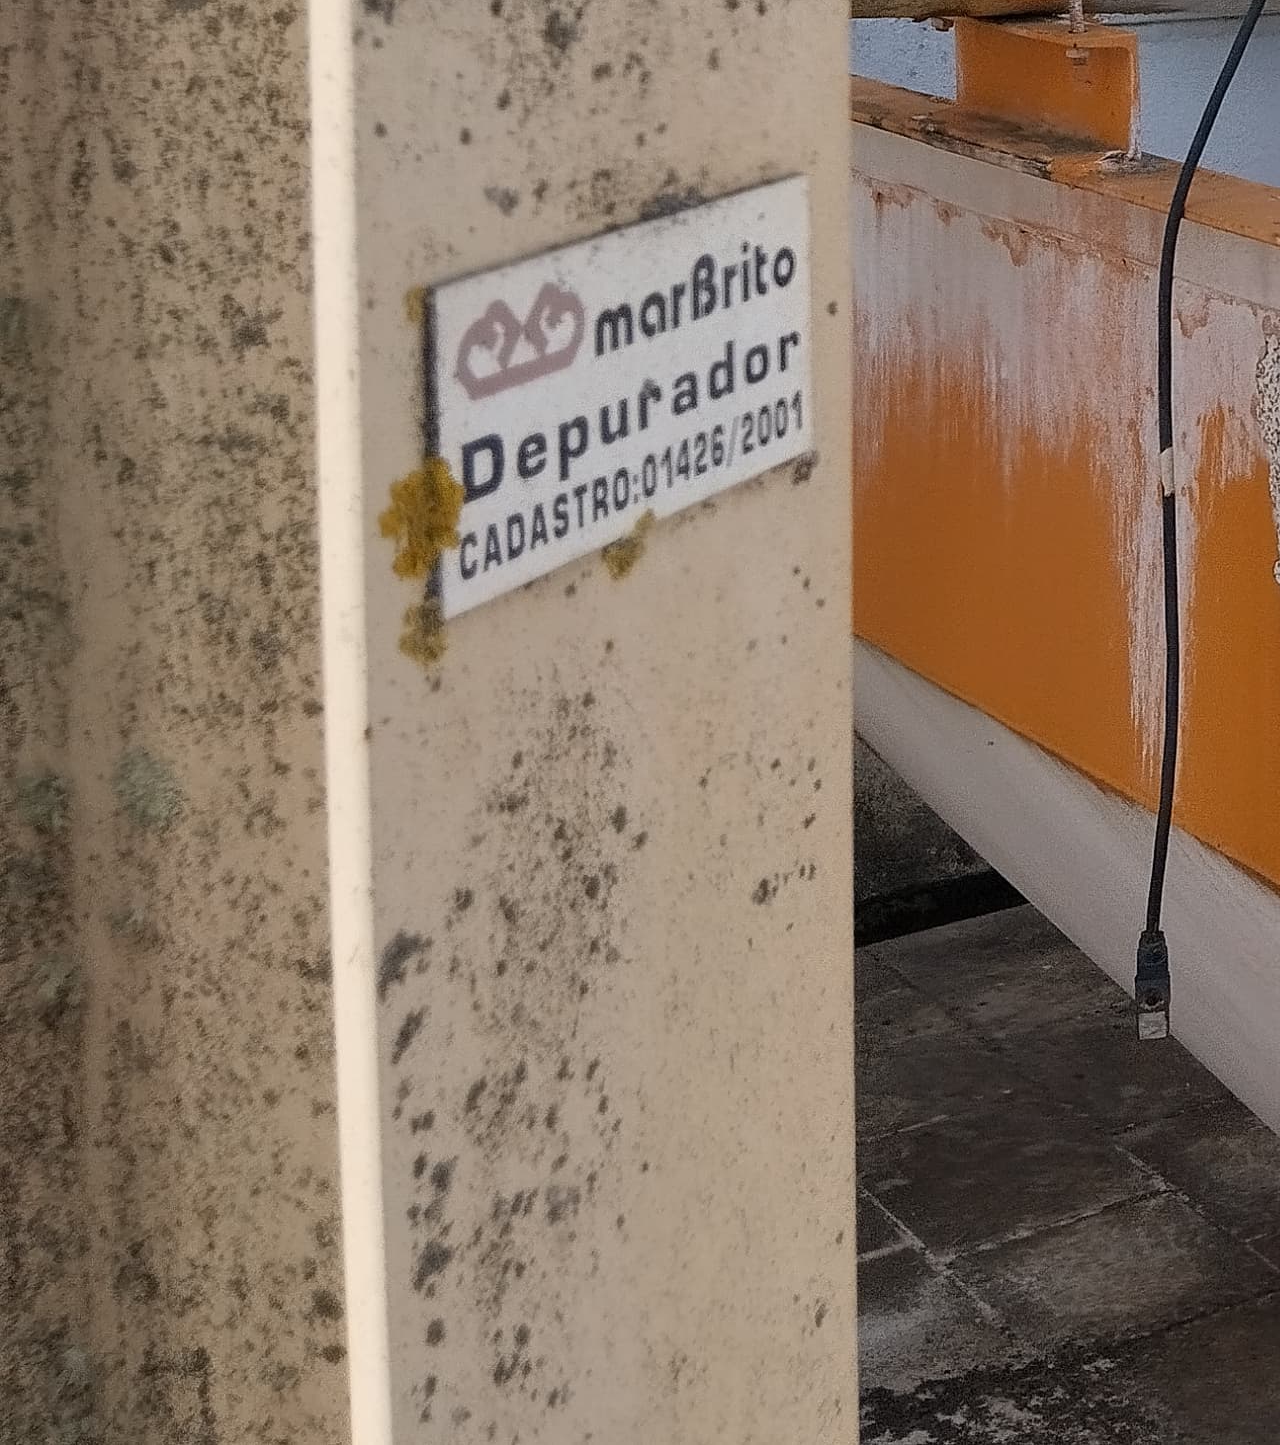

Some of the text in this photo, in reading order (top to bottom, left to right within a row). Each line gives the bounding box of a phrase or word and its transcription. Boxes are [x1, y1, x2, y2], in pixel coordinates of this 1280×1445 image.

[595, 242, 796, 355] marBrito
[459, 390, 803, 580] CADASTRO:01426/2001
[461, 331, 799, 503] Depurador
